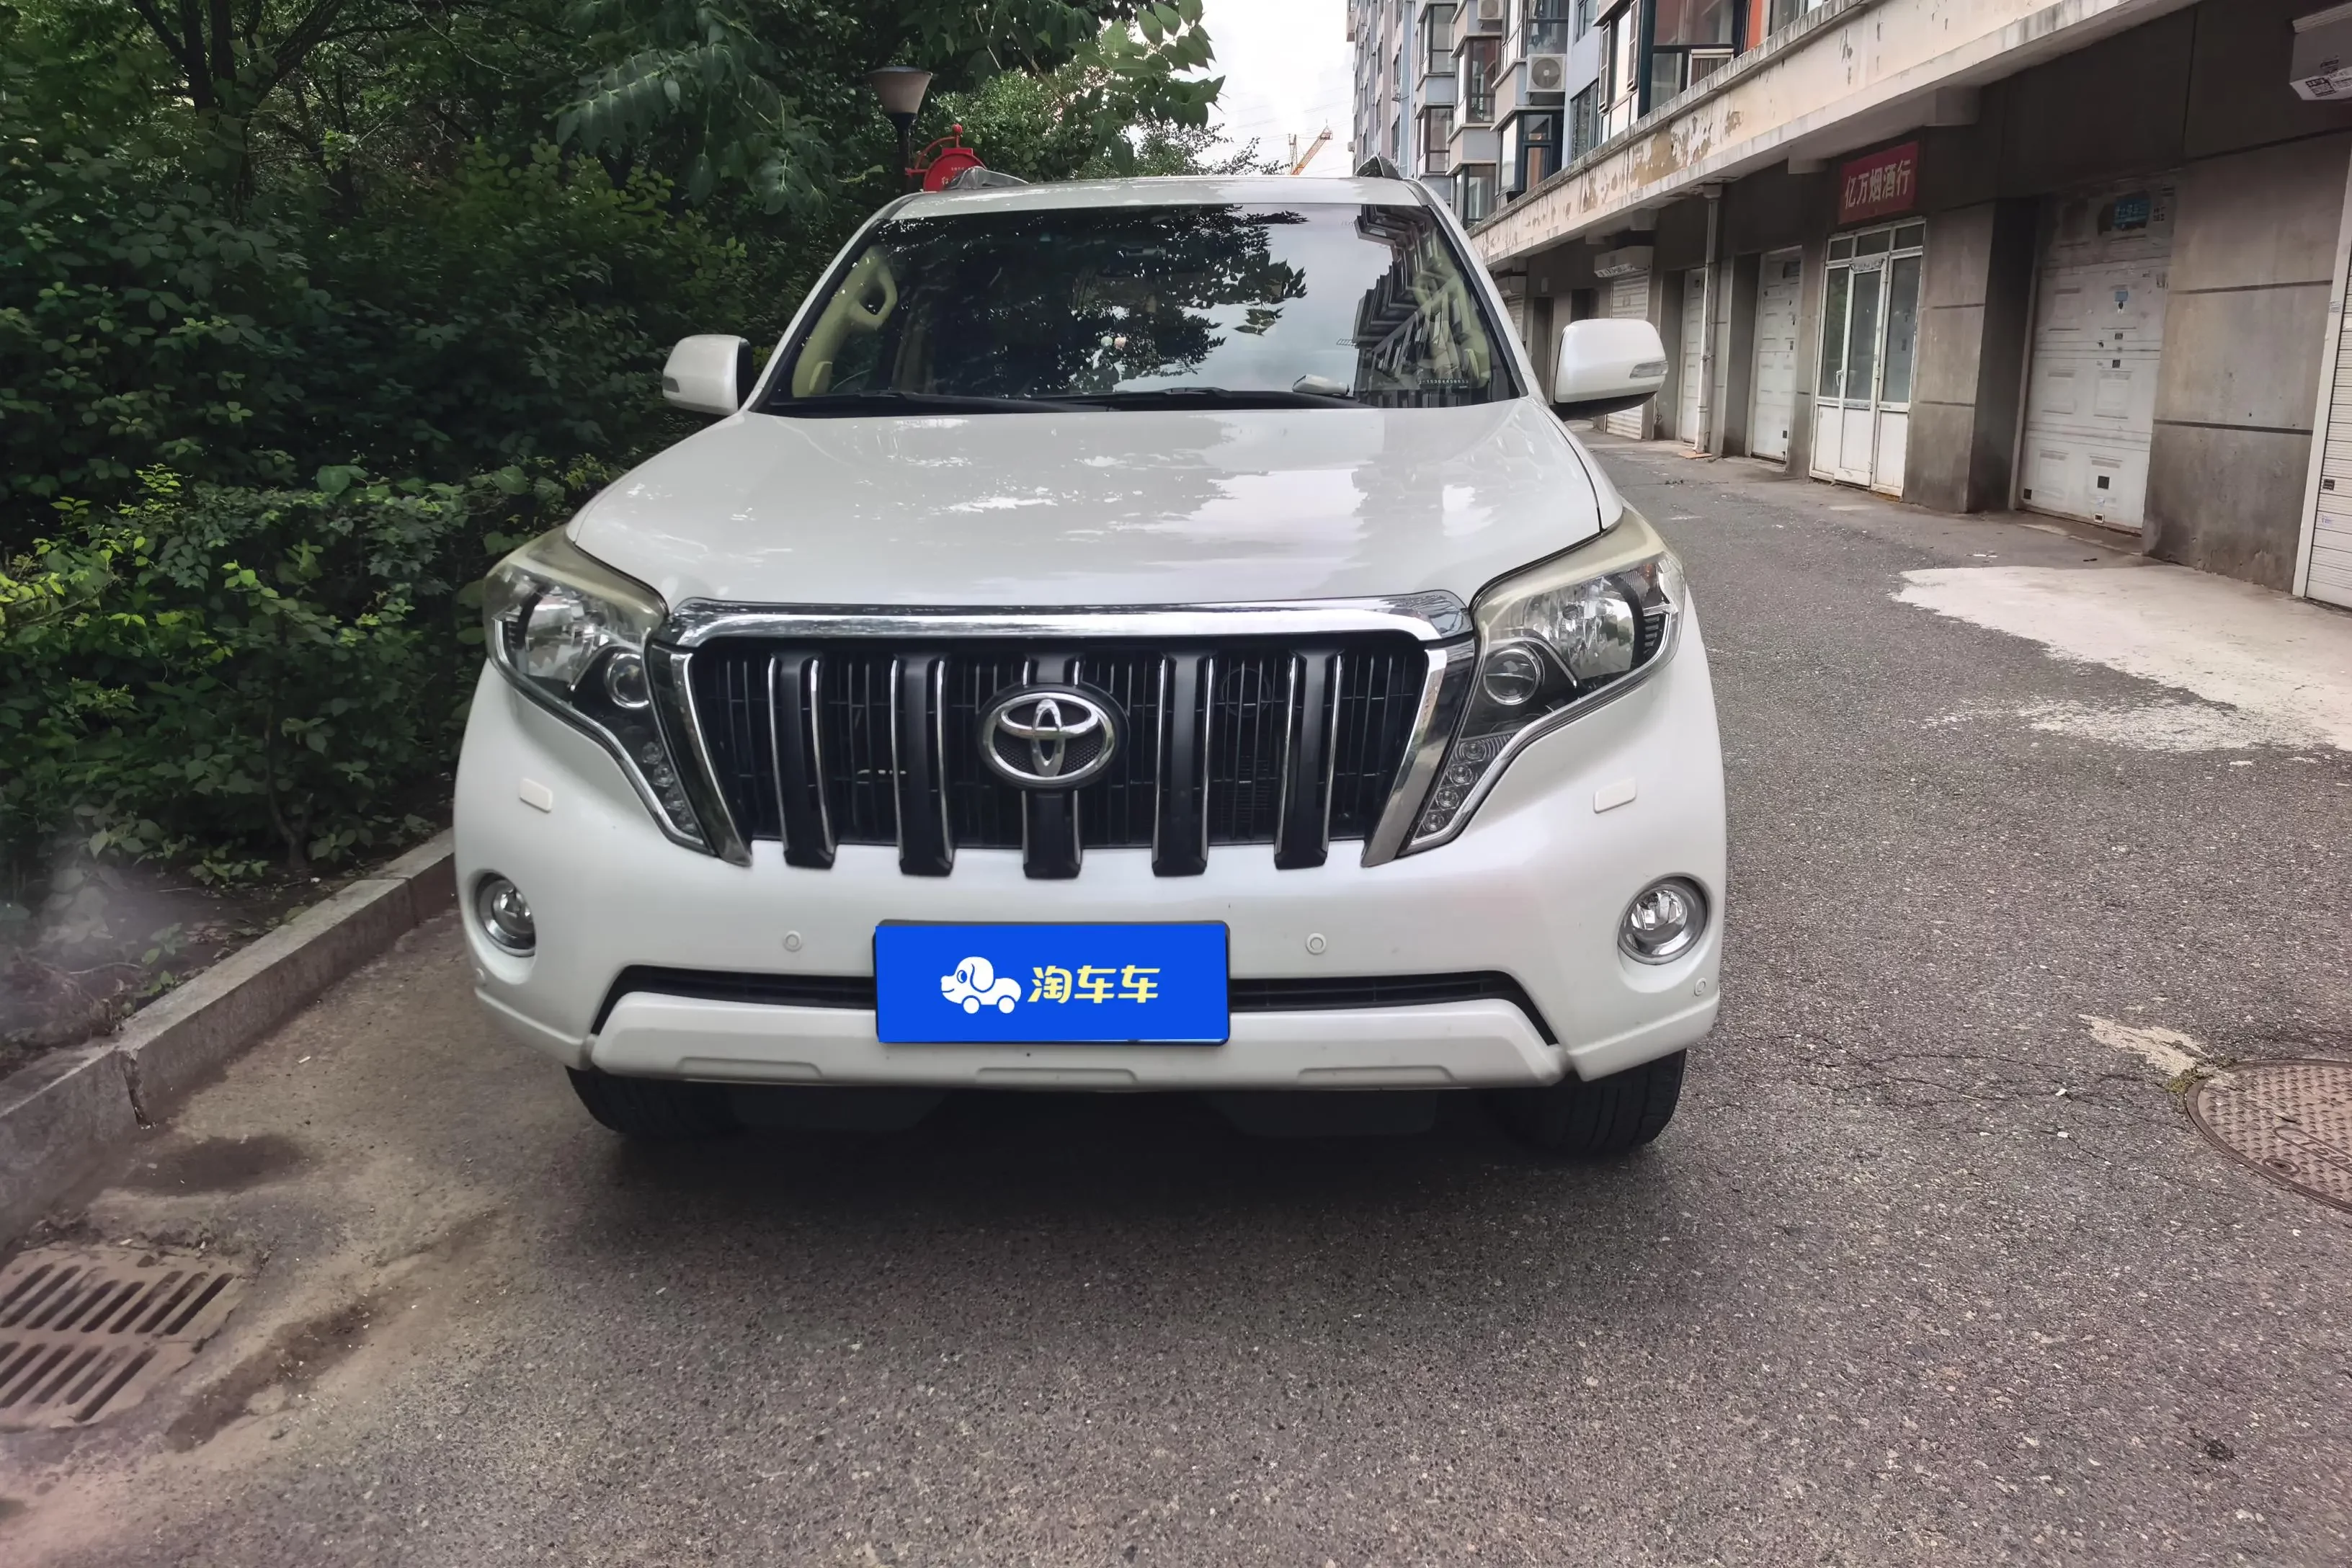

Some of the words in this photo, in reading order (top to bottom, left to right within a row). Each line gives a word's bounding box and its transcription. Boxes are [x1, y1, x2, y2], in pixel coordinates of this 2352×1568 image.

[1845, 159, 1911, 210] 亿万烟酒行
